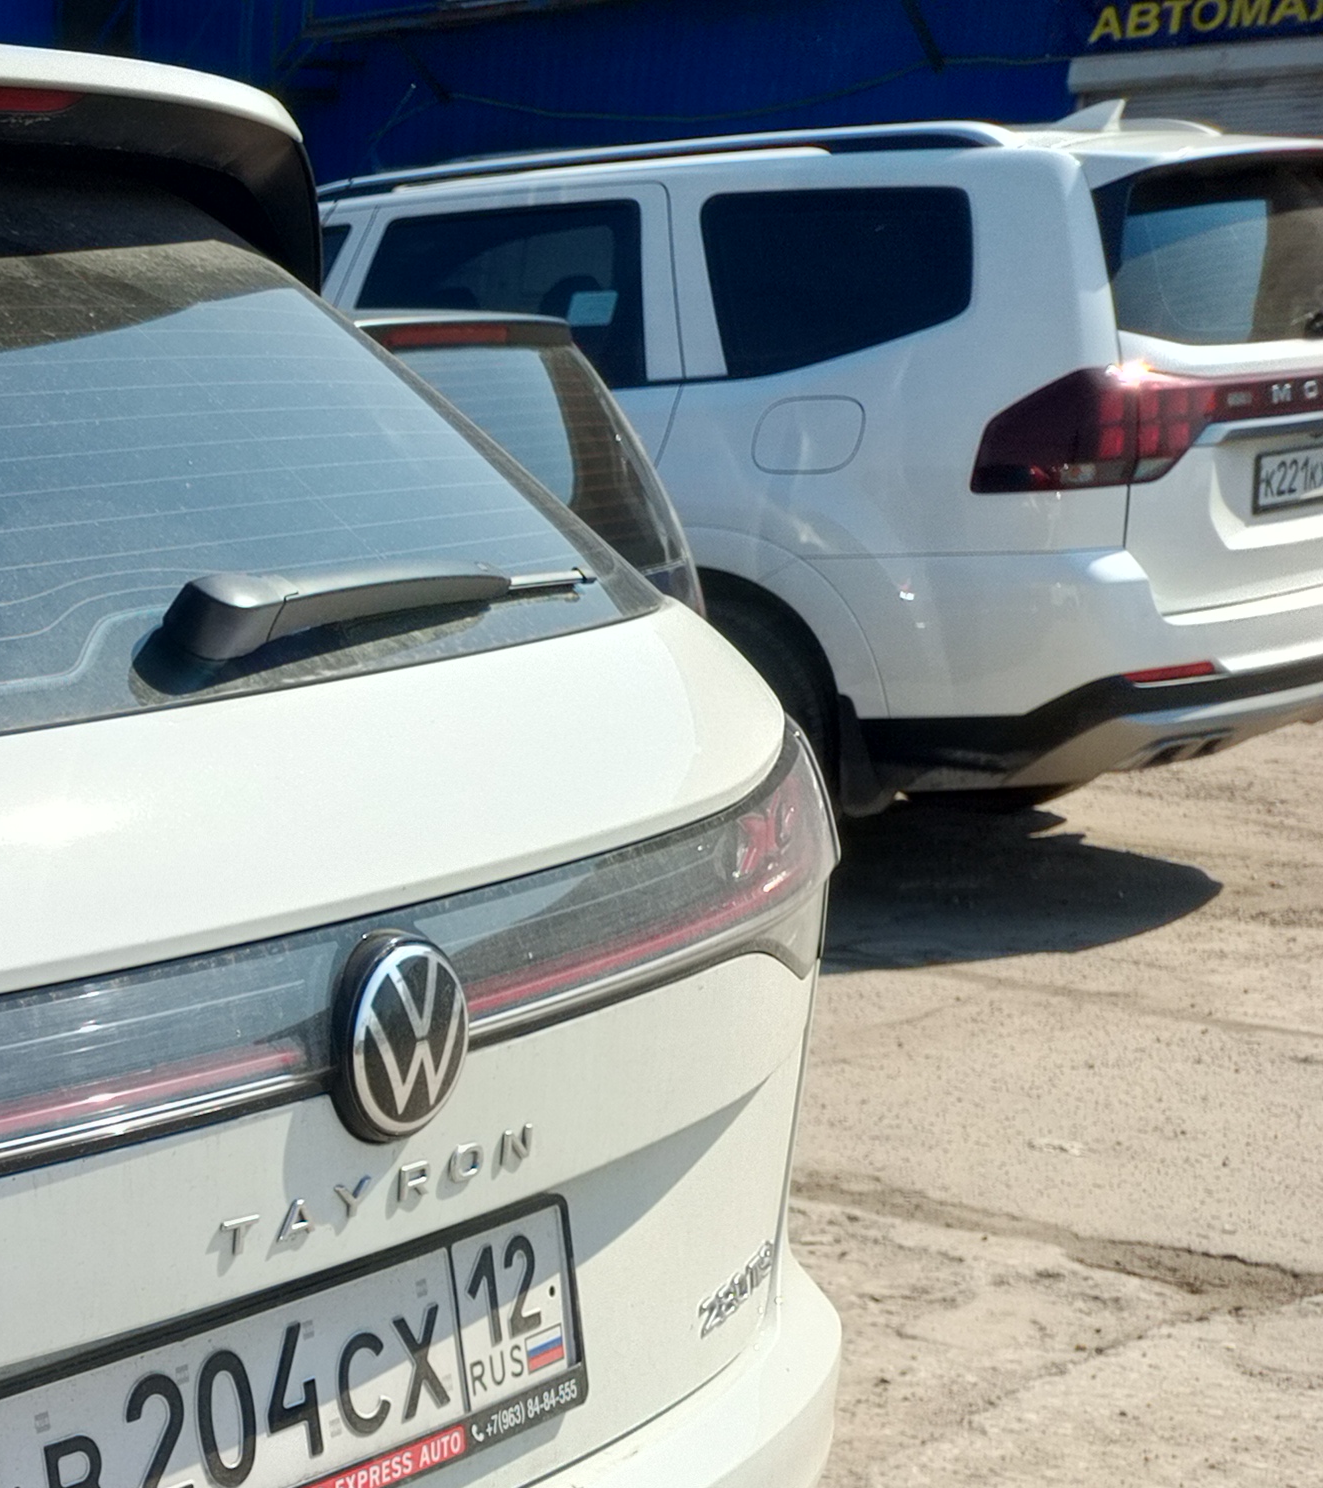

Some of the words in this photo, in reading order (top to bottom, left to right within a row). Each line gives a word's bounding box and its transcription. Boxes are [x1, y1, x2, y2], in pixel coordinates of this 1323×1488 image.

[1087, 0, 1323, 43] АВТОМА
[1263, 456, 1323, 497] К221К
[220, 1122, 533, 1256] TAYRON
[465, 1233, 543, 1347] 12
[469, 1344, 525, 1397] RUS
[485, 1401, 526, 1437] +7(963)
[526, 1378, 578, 1419] 84-84-555
[418, 1431, 463, 1469] AUTO
